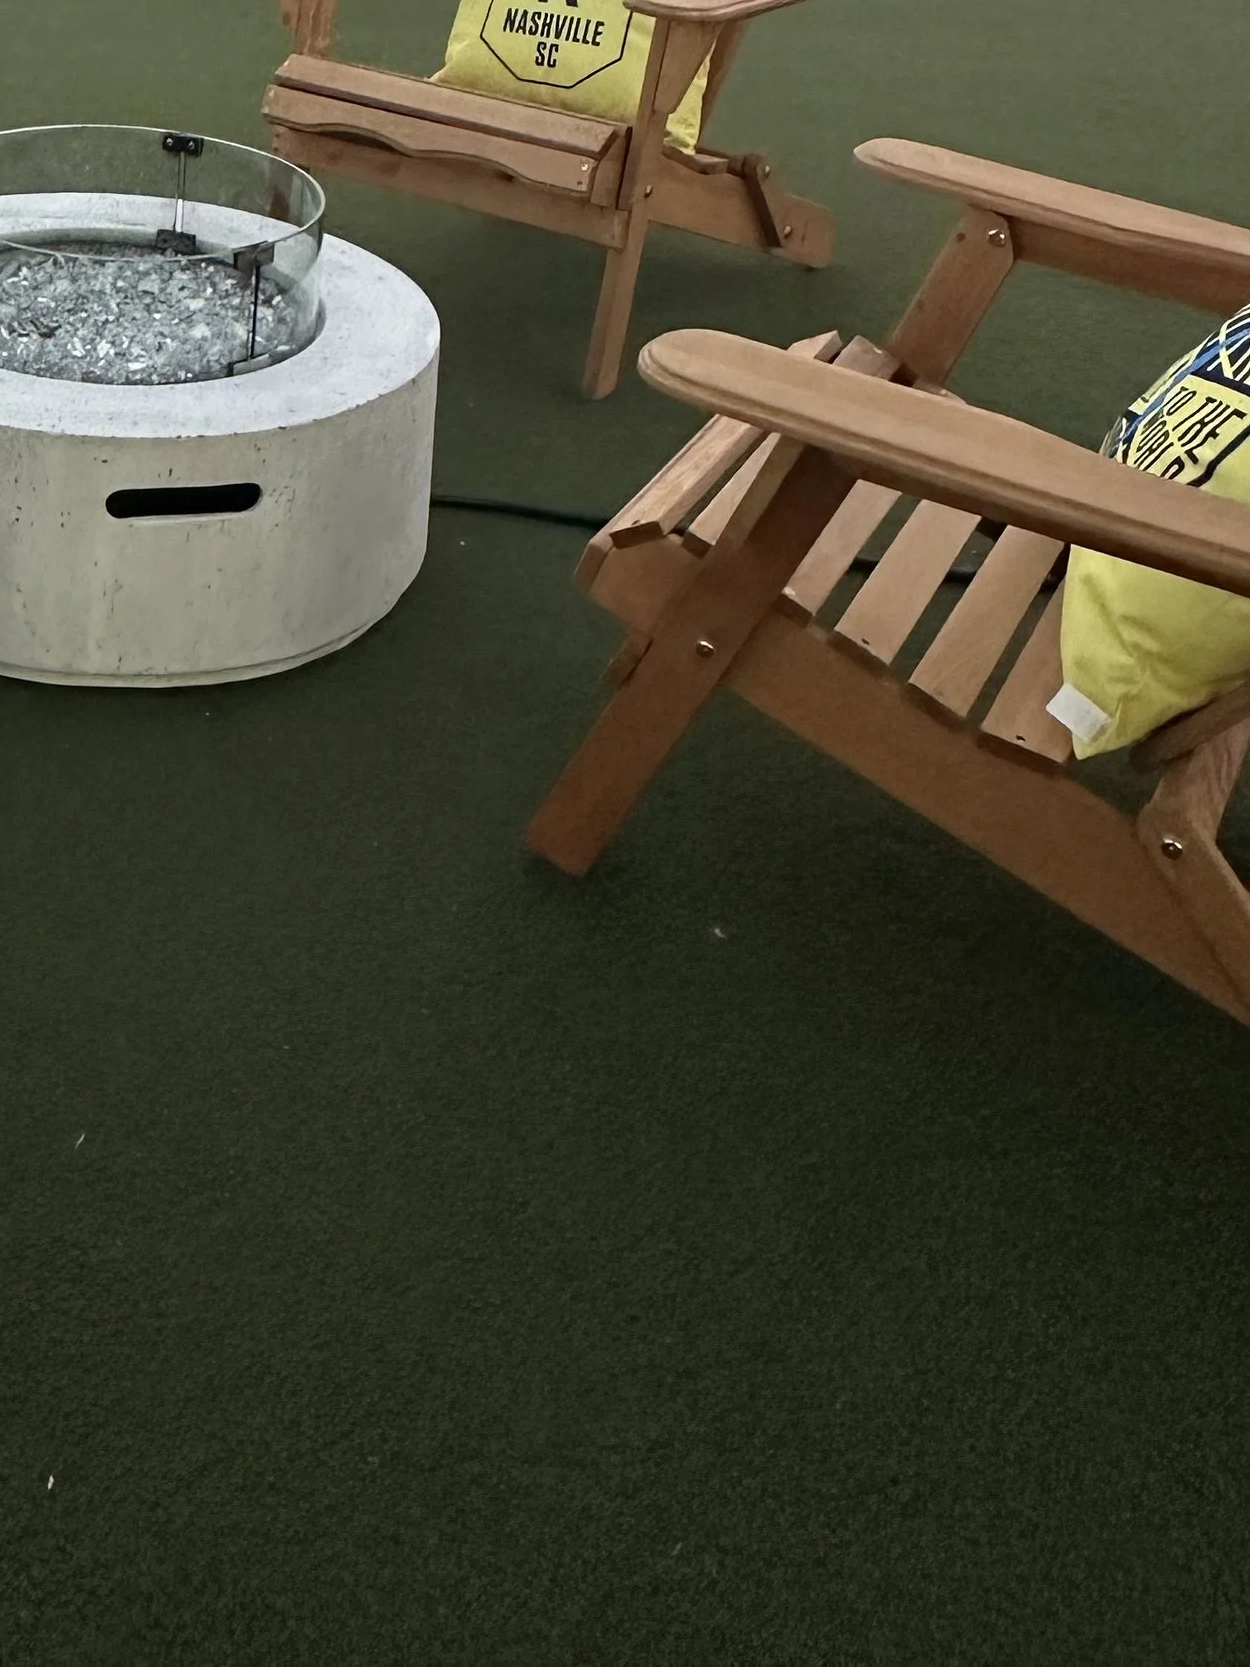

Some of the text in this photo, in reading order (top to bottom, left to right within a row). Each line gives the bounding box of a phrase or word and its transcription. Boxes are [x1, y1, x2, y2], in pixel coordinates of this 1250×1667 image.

[503, 8, 605, 47] NASHVILLE
[535, 42, 559, 68] SC
[1160, 386, 1249, 465] TO THE
